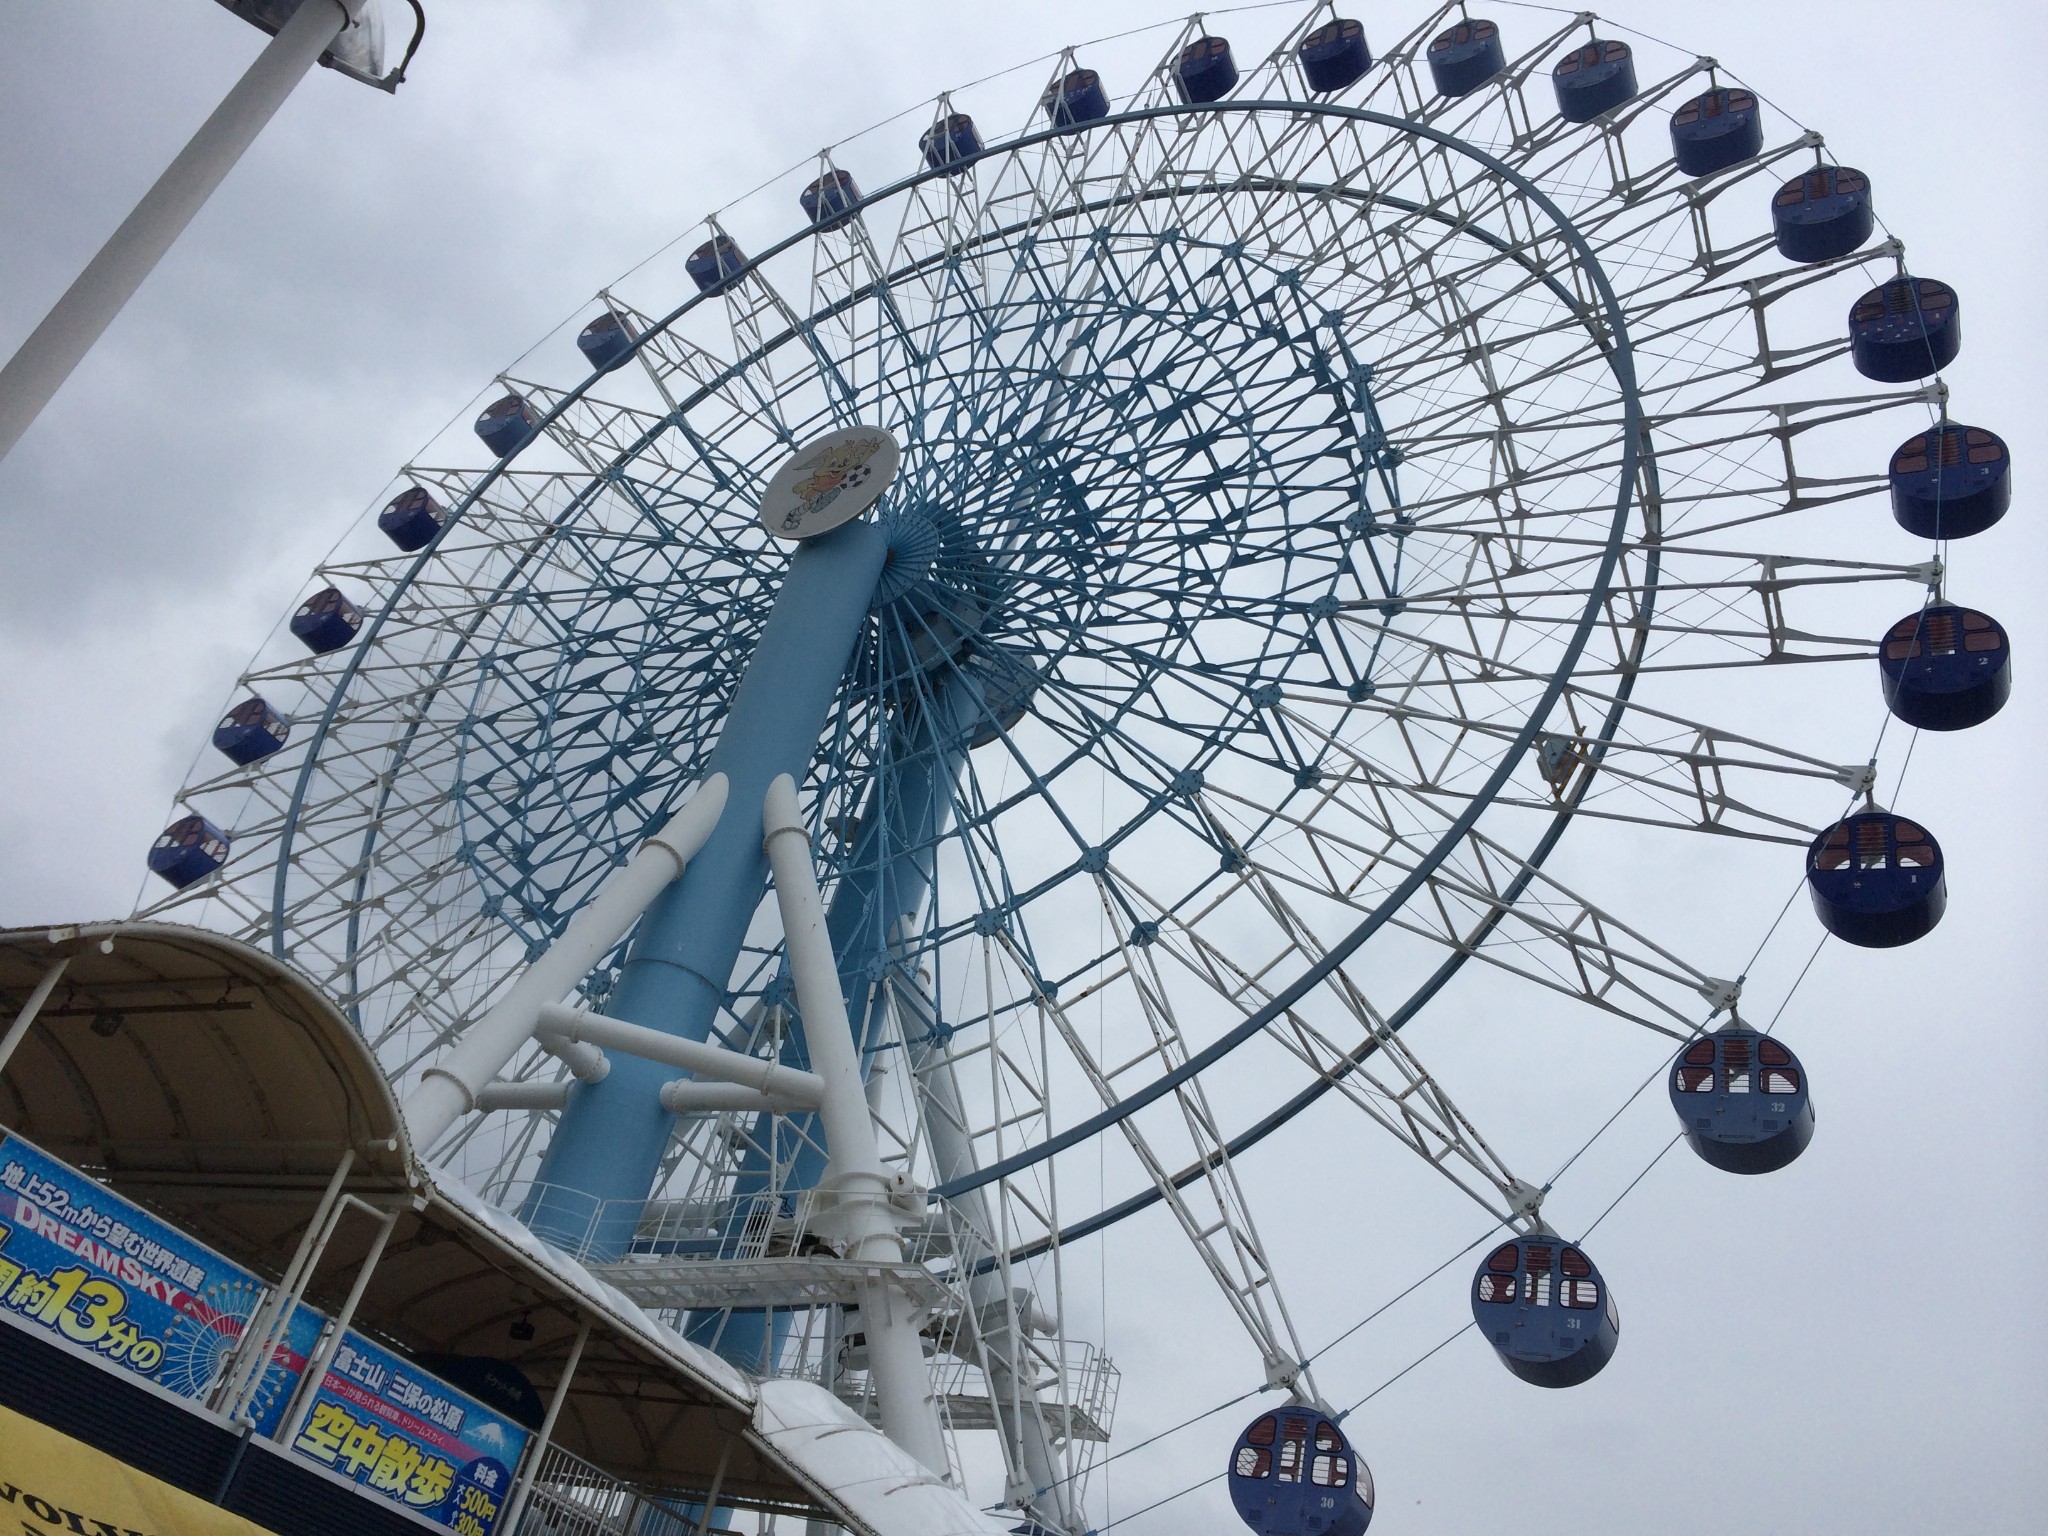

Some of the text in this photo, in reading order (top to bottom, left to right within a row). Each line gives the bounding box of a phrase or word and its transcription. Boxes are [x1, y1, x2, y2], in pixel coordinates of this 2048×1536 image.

[1978, 657, 1988, 665] 2
[1771, 1102, 1785, 1112] 32
[1, 1161, 206, 1290] 地上52mから望む世界遺産
[14, 1196, 181, 1306] DREAMSKY
[1566, 1317, 1581, 1330] 31
[295, 1402, 455, 1504] 空中散歩
[474, 1463, 498, 1488] 料金
[461, 1486, 497, 1522] 500円
[1320, 1496, 1335, 1509] 30
